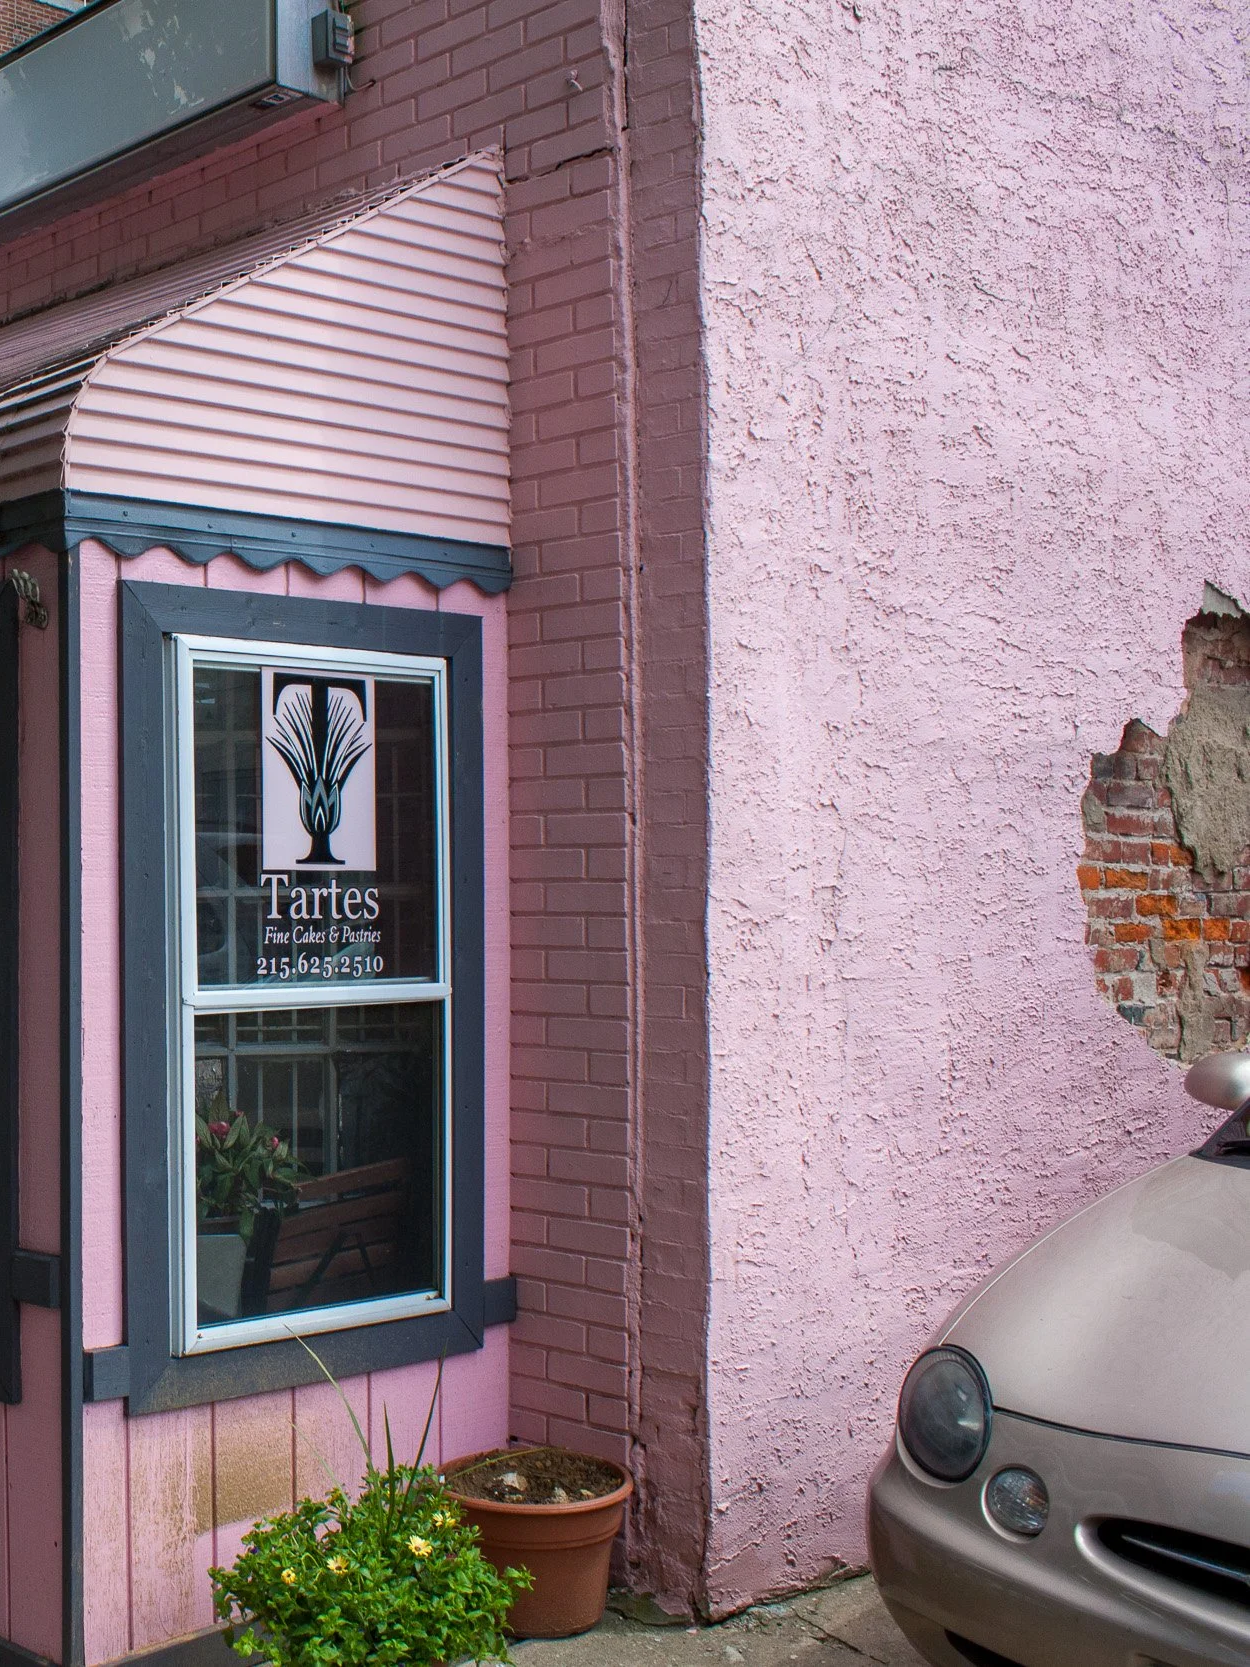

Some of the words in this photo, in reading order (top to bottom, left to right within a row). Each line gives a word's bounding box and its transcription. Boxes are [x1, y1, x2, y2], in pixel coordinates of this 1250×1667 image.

[260, 873, 380, 920] Tartes
[264, 926, 290, 944] Fine
[292, 925, 326, 944] Cakes
[329, 926, 340, 943] &
[341, 925, 381, 943] Pastries
[256, 952, 384, 979] 215.625.2510
